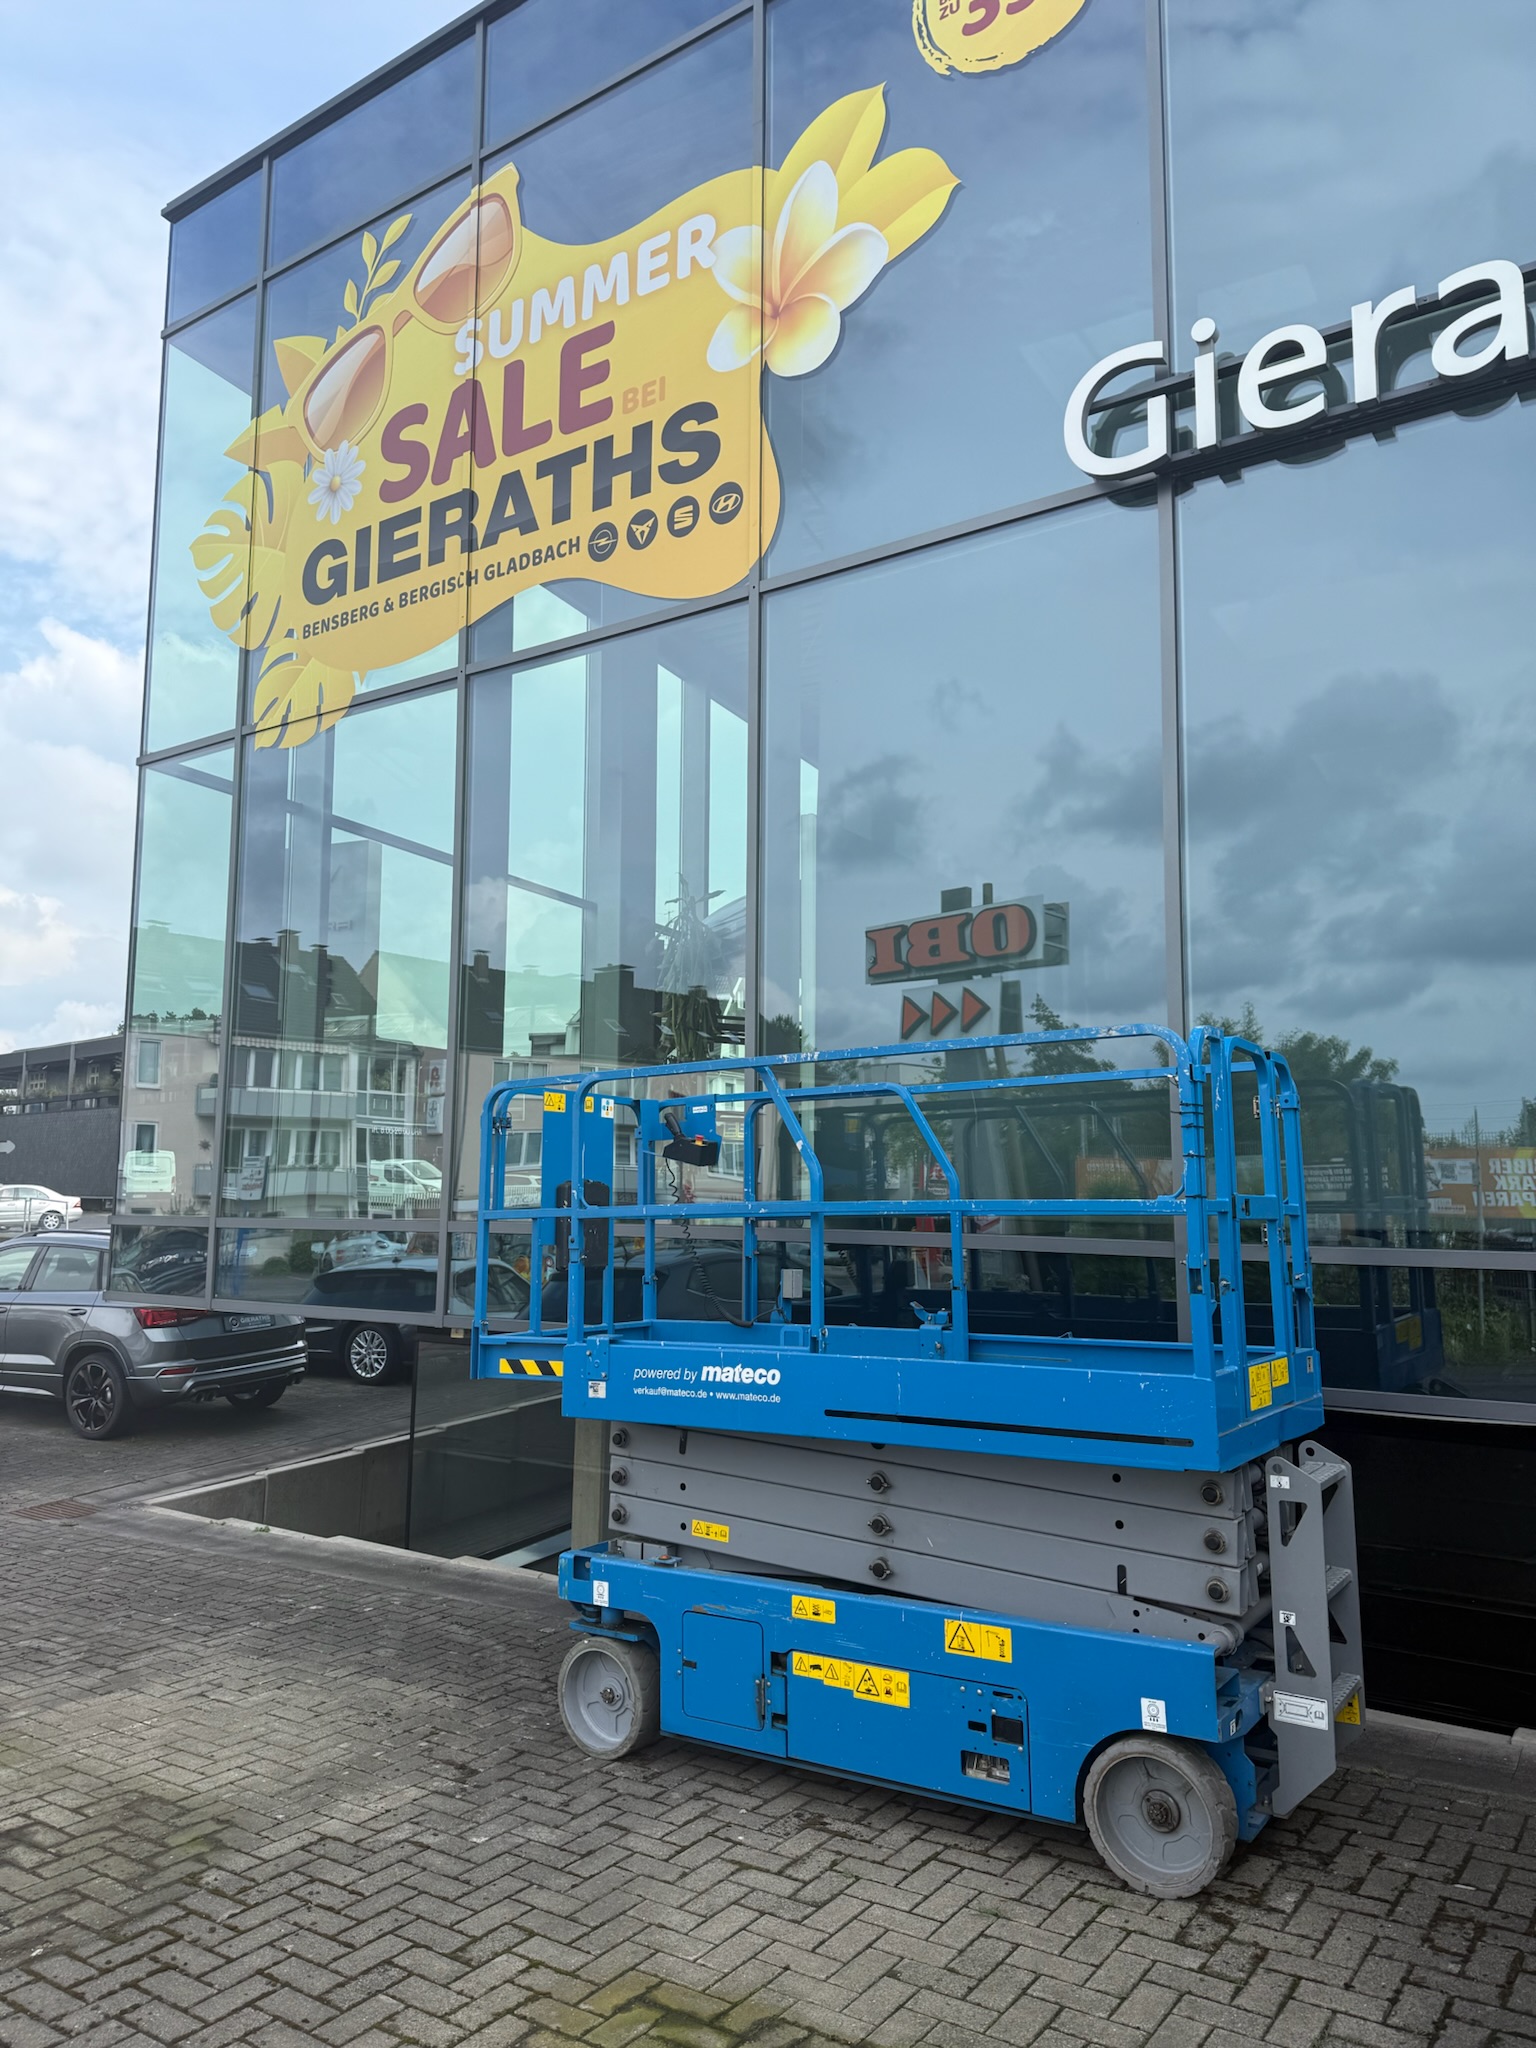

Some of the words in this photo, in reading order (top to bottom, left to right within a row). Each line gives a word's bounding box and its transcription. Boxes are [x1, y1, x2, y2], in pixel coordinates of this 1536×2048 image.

[453, 213, 718, 376] SUMMER
[1063, 259, 1530, 476] Giera
[379, 320, 615, 503] SALE
[622, 376, 666, 415] BEI
[301, 401, 721, 606] GIERATHS
[302, 601, 379, 640] BENSBERG
[383, 597, 395, 613] &
[399, 569, 479, 609] BERGISCH
[483, 536, 581, 581] GLADBACH
[633, 1368, 681, 1380] powered
[684, 1368, 698, 1384] by
[701, 1363, 781, 1386] mateco
[633, 1386, 707, 1398] verkauf@mateco.de
[716, 1392, 781, 1403] www.mateco.de
